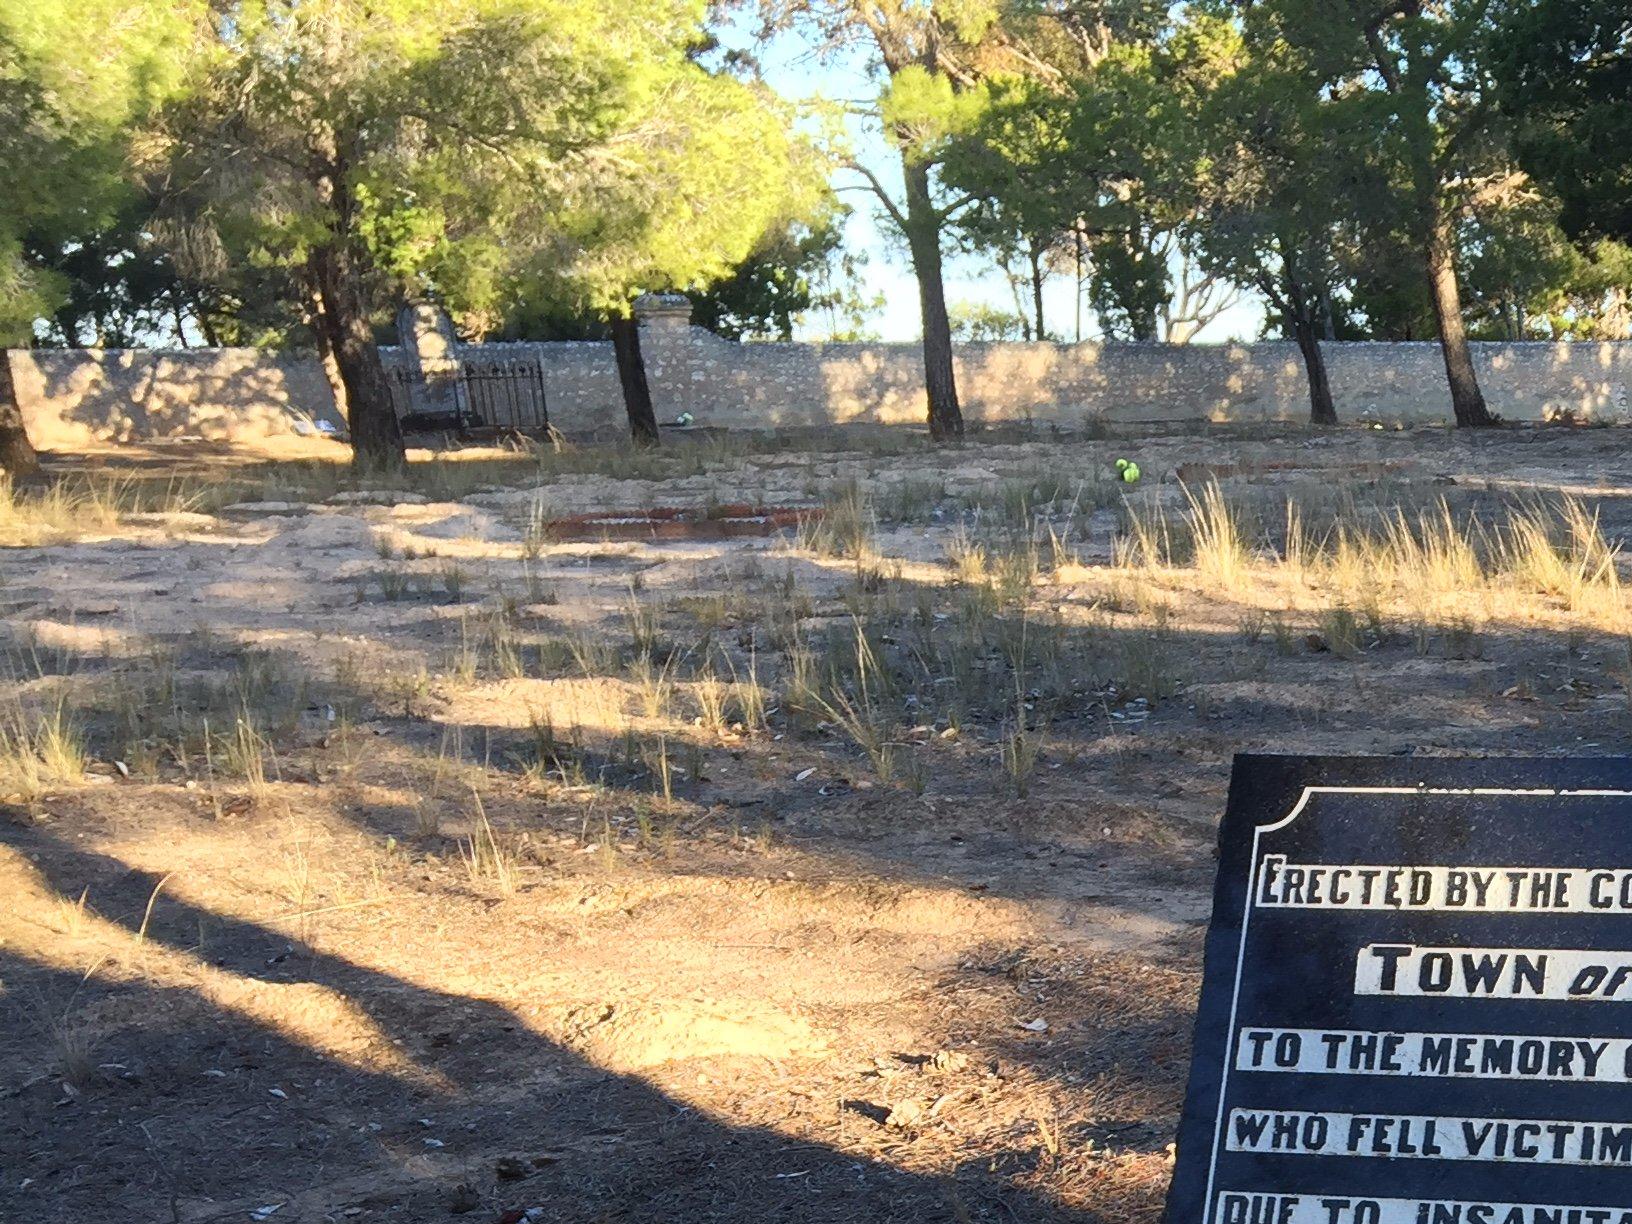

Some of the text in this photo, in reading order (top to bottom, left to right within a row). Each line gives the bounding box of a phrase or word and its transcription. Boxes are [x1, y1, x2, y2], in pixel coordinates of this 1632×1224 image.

[1260, 856, 1432, 906] ERECTED
[1446, 870, 1493, 906] BY
[1506, 871, 1572, 909] THE
[1370, 945, 1549, 996] TOWN
[1247, 1031, 1300, 1067] TO
[1321, 1031, 1404, 1073] THE
[1418, 1037, 1607, 1077] MEMORY
[1232, 1113, 1327, 1151] WHO
[1347, 1118, 1442, 1157] FELL
